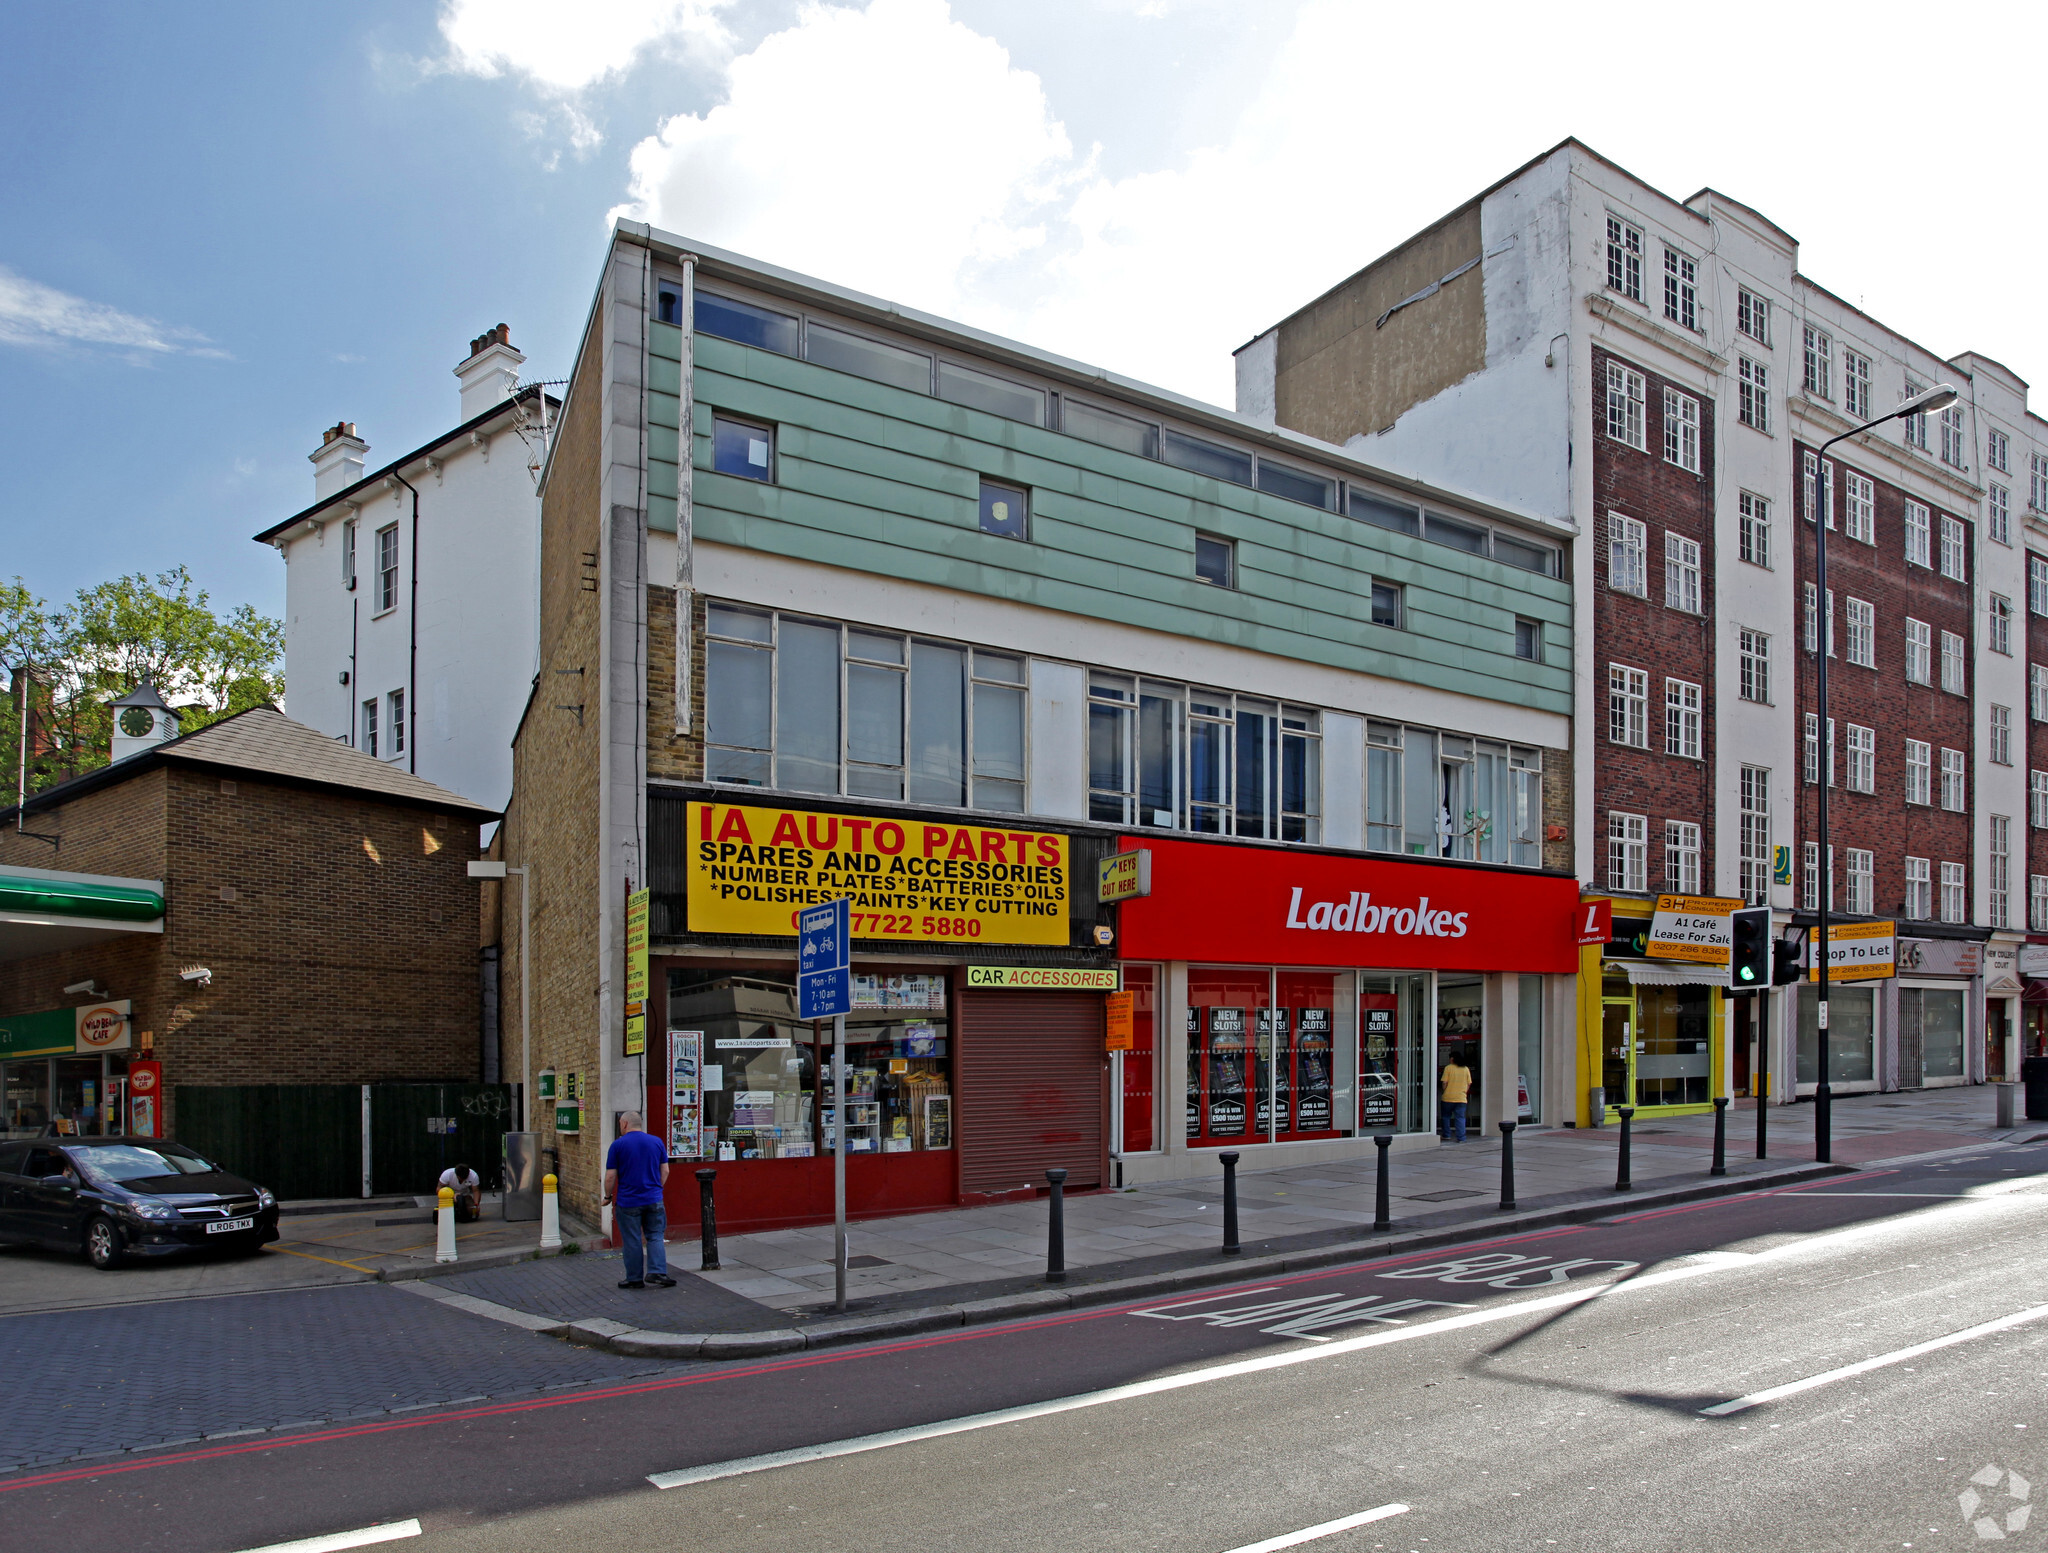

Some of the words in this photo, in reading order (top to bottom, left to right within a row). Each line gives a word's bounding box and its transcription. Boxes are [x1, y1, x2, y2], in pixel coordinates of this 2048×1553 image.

[770, 813, 905, 855] AUTO
[923, 826, 1061, 867] PARTS
[700, 842, 813, 868] SPARES
[823, 851, 882, 873] AND
[889, 856, 1063, 885] ACCESSORIES
[1119, 857, 1136, 873] KEYS
[1102, 882, 1115, 896] CUT
[1118, 878, 1136, 893] HERE
[975, 899, 1058, 916] CUTTING
[1687, 900, 1739, 908] PROPERTY
[1286, 887, 1468, 938] Ladbrokes
[850, 913, 913, 934] 7722
[922, 916, 981, 937] 5880
[1584, 906, 1600, 933] L
[1675, 918, 1688, 927] A1
[1693, 919, 1716, 929] Café
[1578, 935, 1605, 943] Ladbrokes
[1655, 930, 1684, 940] Lease
[1688, 932, 1706, 942] For
[1702, 947, 1728, 955] 8363
[1850, 947, 1865, 957] To
[1870, 945, 1890, 956] Let
[803, 959, 814, 969] taxi
[971, 970, 1004, 984] CAR
[1009, 971, 1114, 987] ACCESSORIES
[1218, 1010, 1238, 1020] NEW
[1305, 1010, 1324, 1020] NEW
[1371, 1012, 1388, 1021] NEW
[101, 1018, 115, 1029] BEA
[1214, 1021, 1241, 1030] SLOTS!
[1302, 1021, 1326, 1029] SLOTS!
[1368, 1022, 1391, 1030] SLOTS!
[210, 1222, 234, 1231] LR06
[1376, 1253, 1640, 1289] BUS
[1128, 1287, 1476, 1341] LANE
